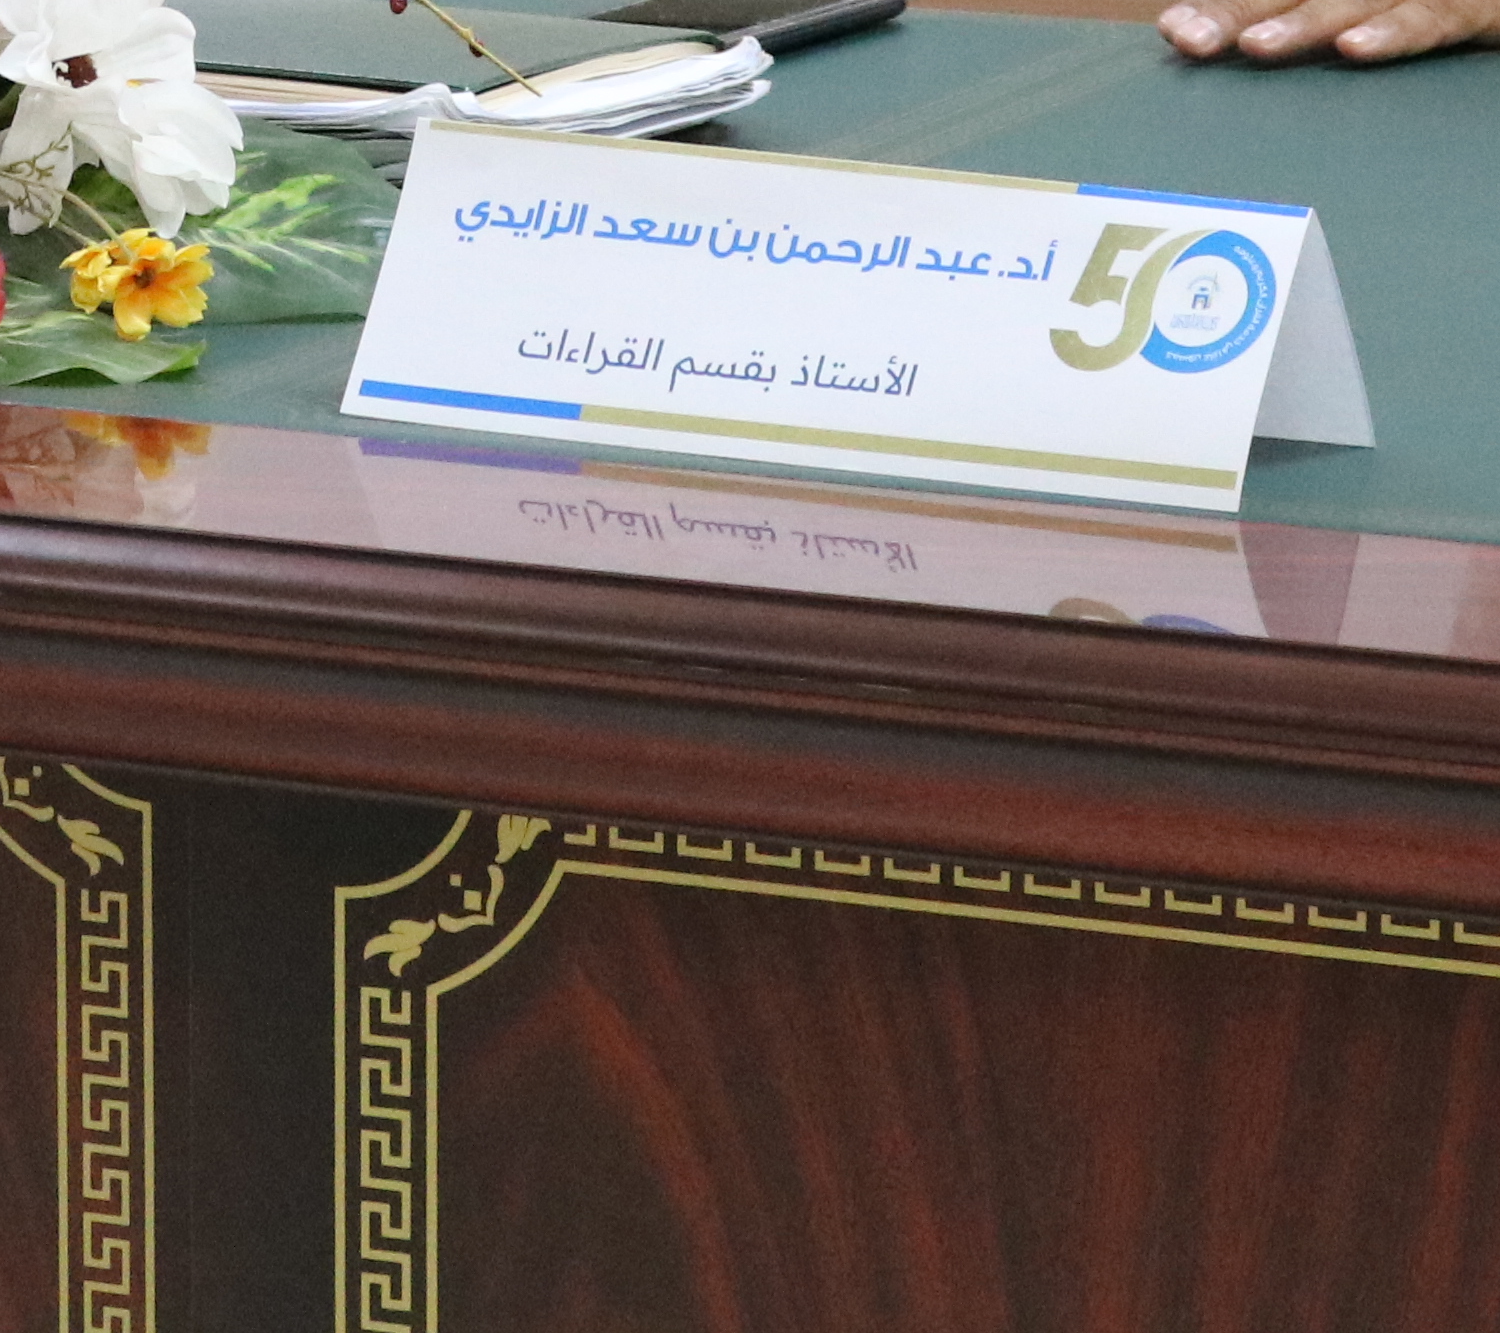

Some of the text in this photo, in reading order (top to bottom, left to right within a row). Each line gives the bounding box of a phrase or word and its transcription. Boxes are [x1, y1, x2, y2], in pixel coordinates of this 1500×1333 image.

[454, 199, 590, 243] الزايدي
[593, 215, 703, 248] سعد
[708, 218, 761, 262] بن
[765, 224, 912, 273] الرحمن
[915, 247, 992, 281] عبد
[1049, 222, 1277, 373] 50
[516, 327, 919, 396] الأستاذ بقسم القراءات
